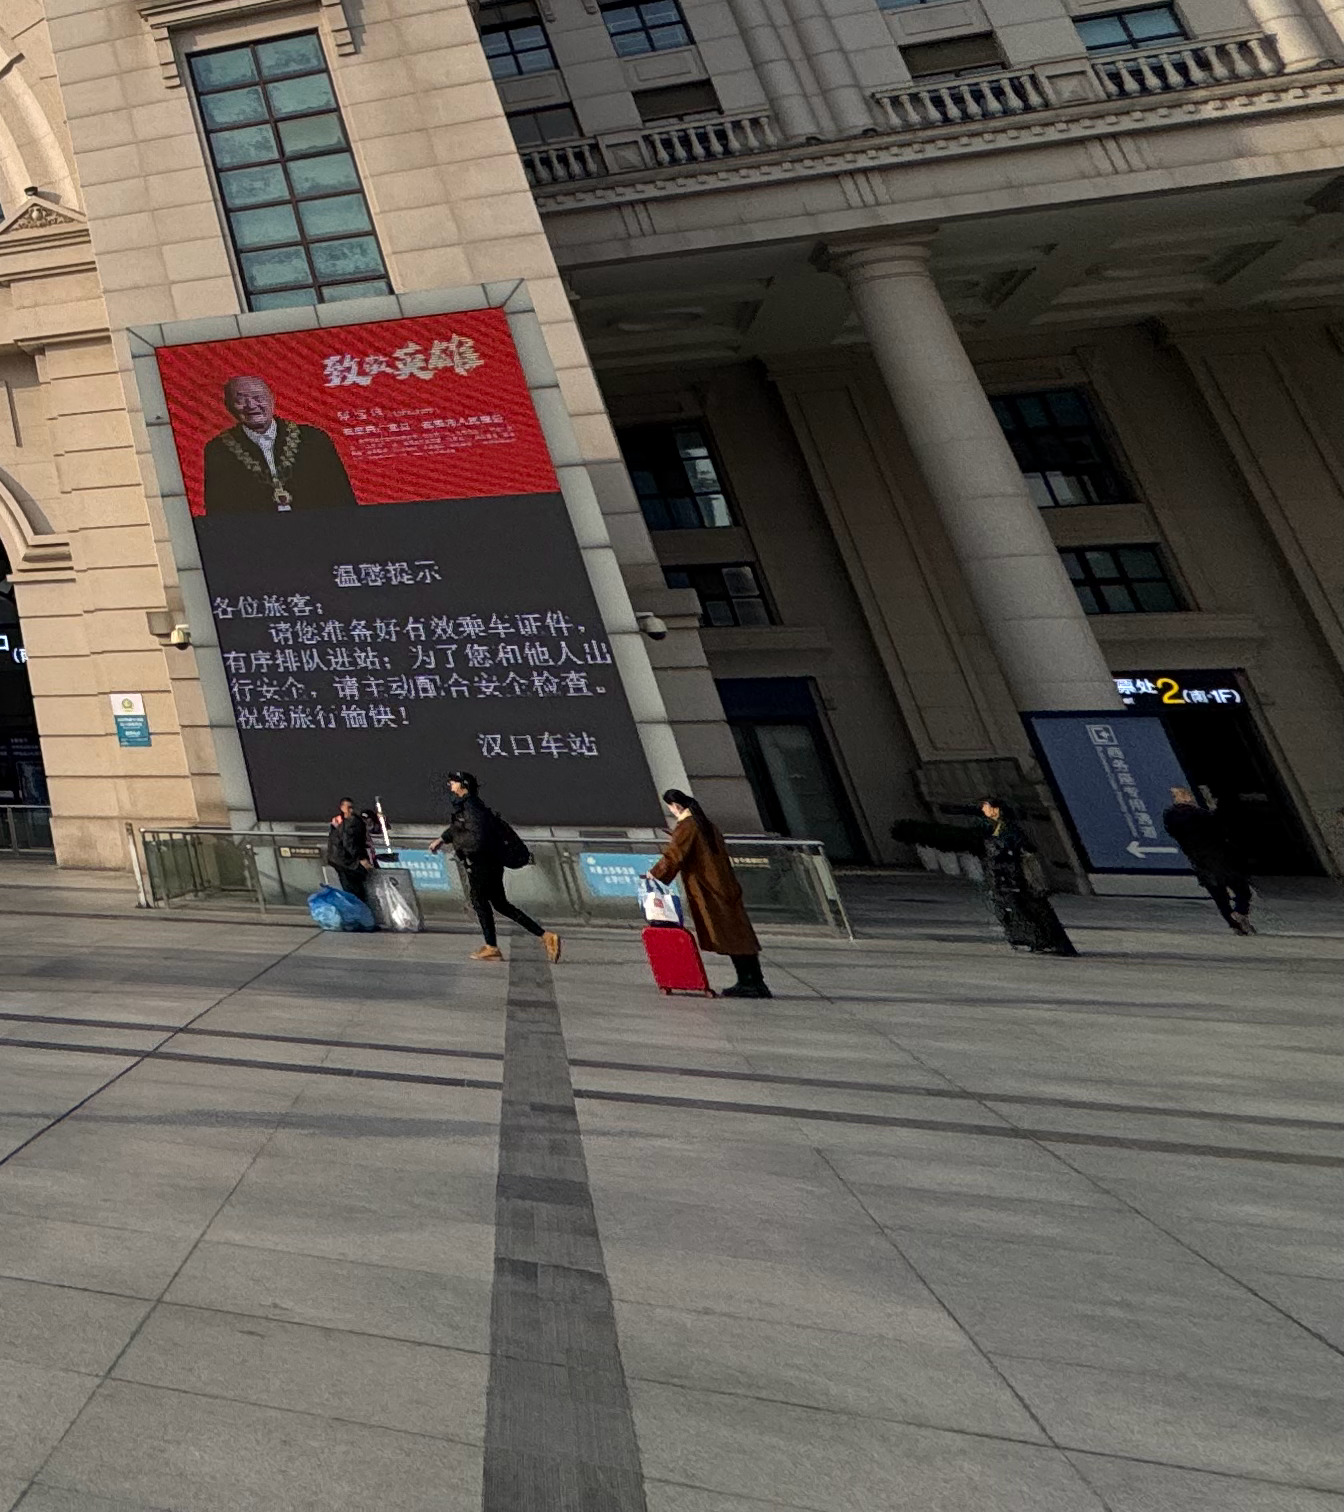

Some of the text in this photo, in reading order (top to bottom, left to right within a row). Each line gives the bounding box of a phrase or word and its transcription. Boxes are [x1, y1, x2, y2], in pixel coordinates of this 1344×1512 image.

[1155, 677, 1186, 704] 2
[476, 731, 599, 759] 汉口车站
